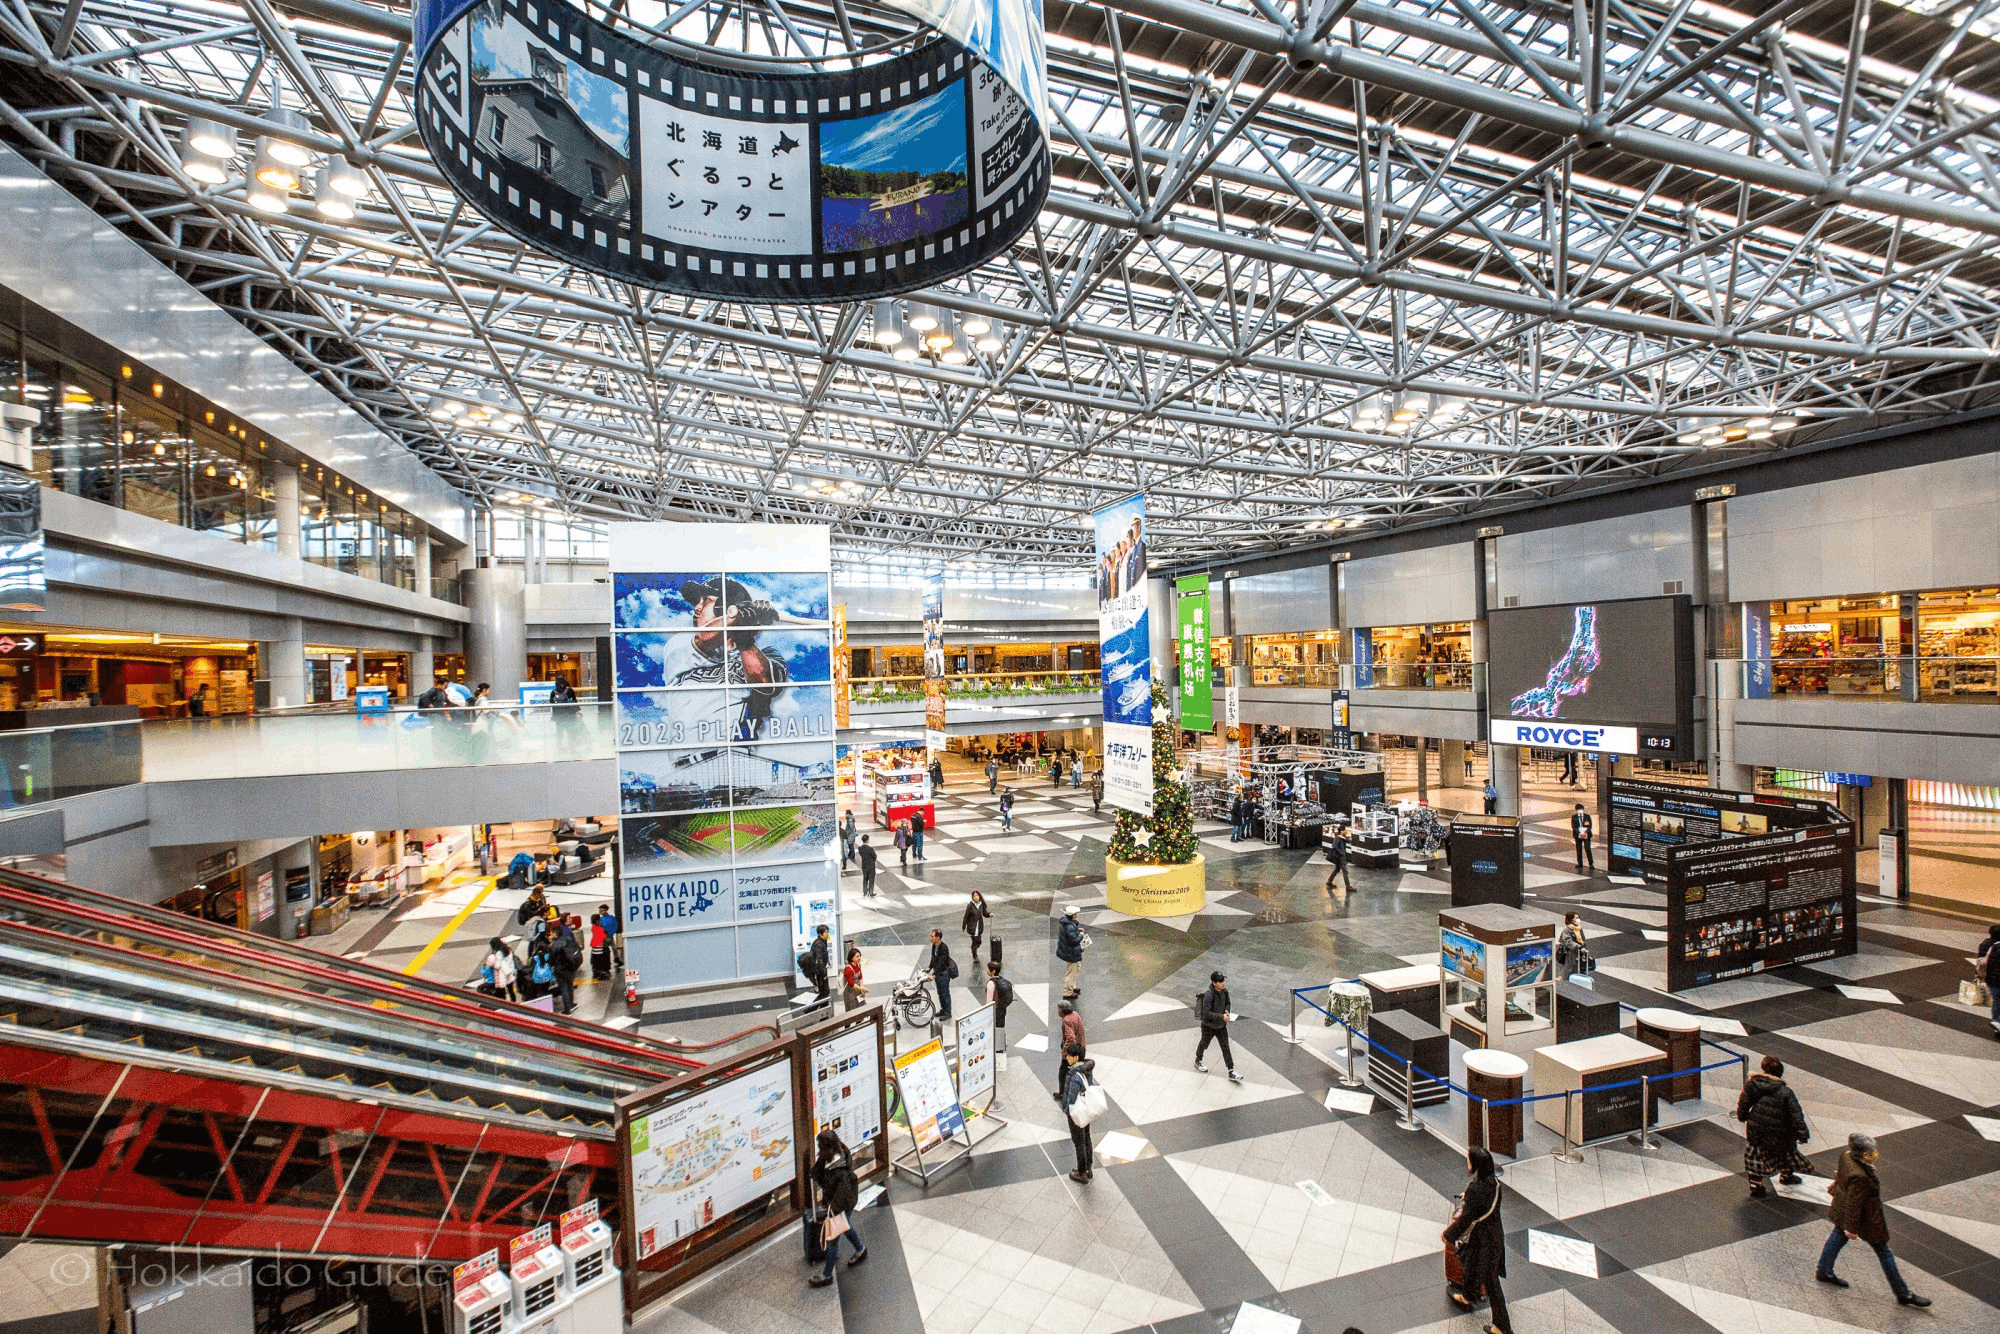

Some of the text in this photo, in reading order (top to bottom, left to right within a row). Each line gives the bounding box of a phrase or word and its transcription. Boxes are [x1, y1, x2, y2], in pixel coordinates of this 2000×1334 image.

[981, 113, 1000, 132] Take
[996, 105, 1019, 135] across
[666, 121, 758, 155] 北海道
[986, 115, 1032, 169] エスカレーター
[667, 158, 784, 190] ぐるっと
[667, 192, 786, 221] シアター
[667, 224, 708, 236] HOKKAIDO
[621, 715, 829, 745] 2023 PLAY BALL
[1516, 726, 1604, 747] ROYCE'
[1107, 741, 1147, 762] 太平洋フェリー
[1647, 737, 1670, 748] 10:13
[1612, 795, 1655, 807] INTRODUCTION
[738, 875, 780, 884] ファイターズは
[629, 879, 720, 902] HOKKAIDO
[738, 886, 797, 898] 北海道179市町村を
[1120, 885, 1139, 896] Merry
[1140, 887, 1175, 896] Christmas
[630, 901, 687, 922] PRIDE
[739, 900, 784, 911] 応援しています
[900, 1067, 909, 1079] 3F
